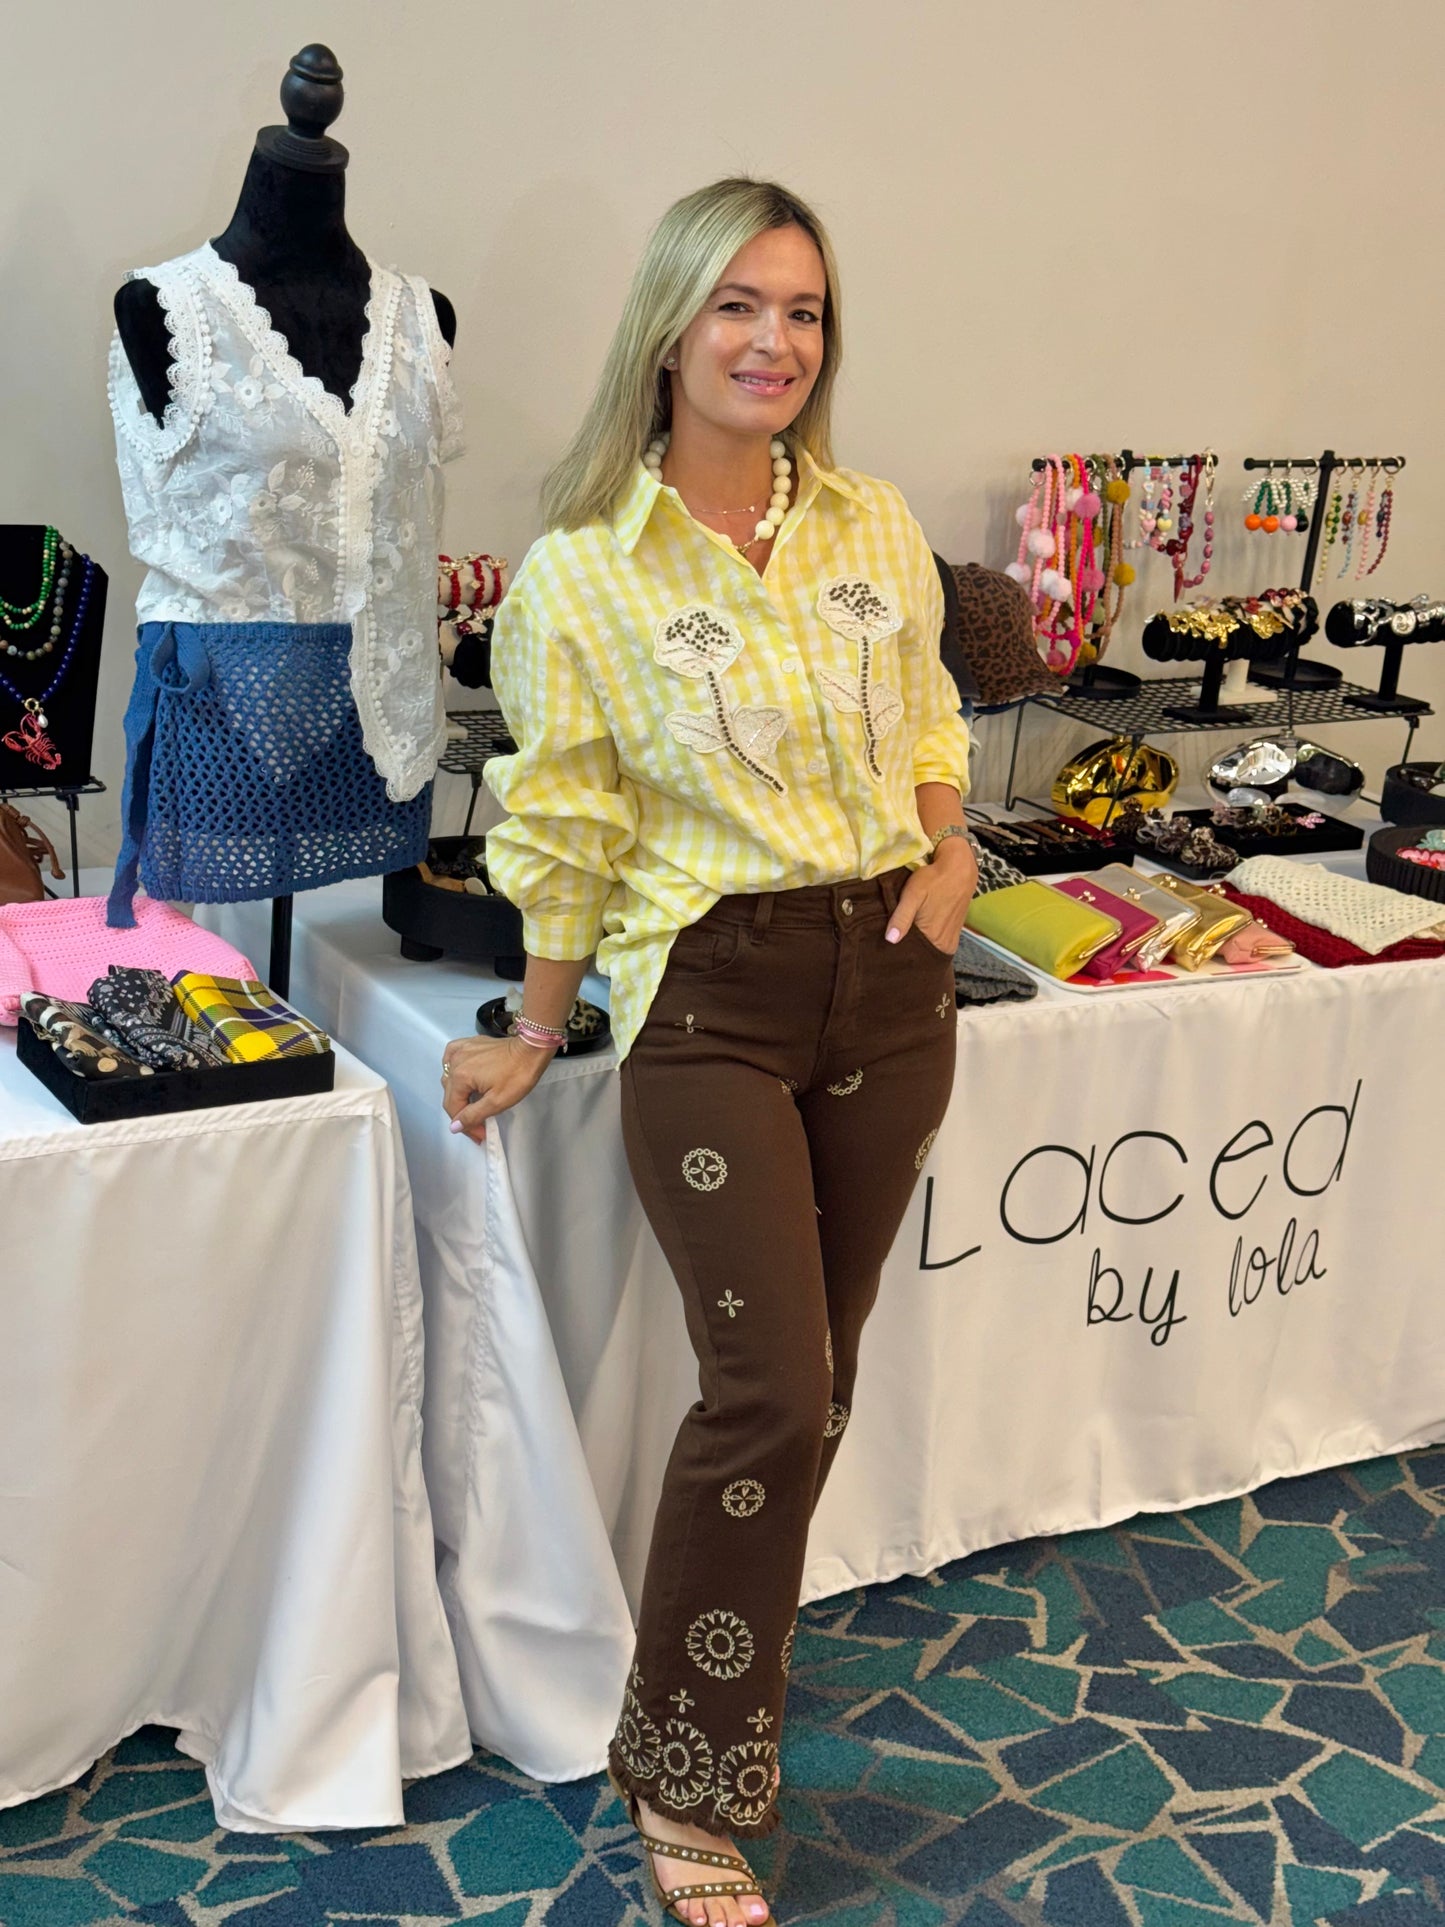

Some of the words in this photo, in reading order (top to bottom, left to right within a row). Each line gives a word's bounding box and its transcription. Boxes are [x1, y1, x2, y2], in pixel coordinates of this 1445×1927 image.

[918, 1078, 1363, 1271] Laced
[1086, 1248, 1188, 1347] by
[1228, 1217, 1328, 1318] lola
